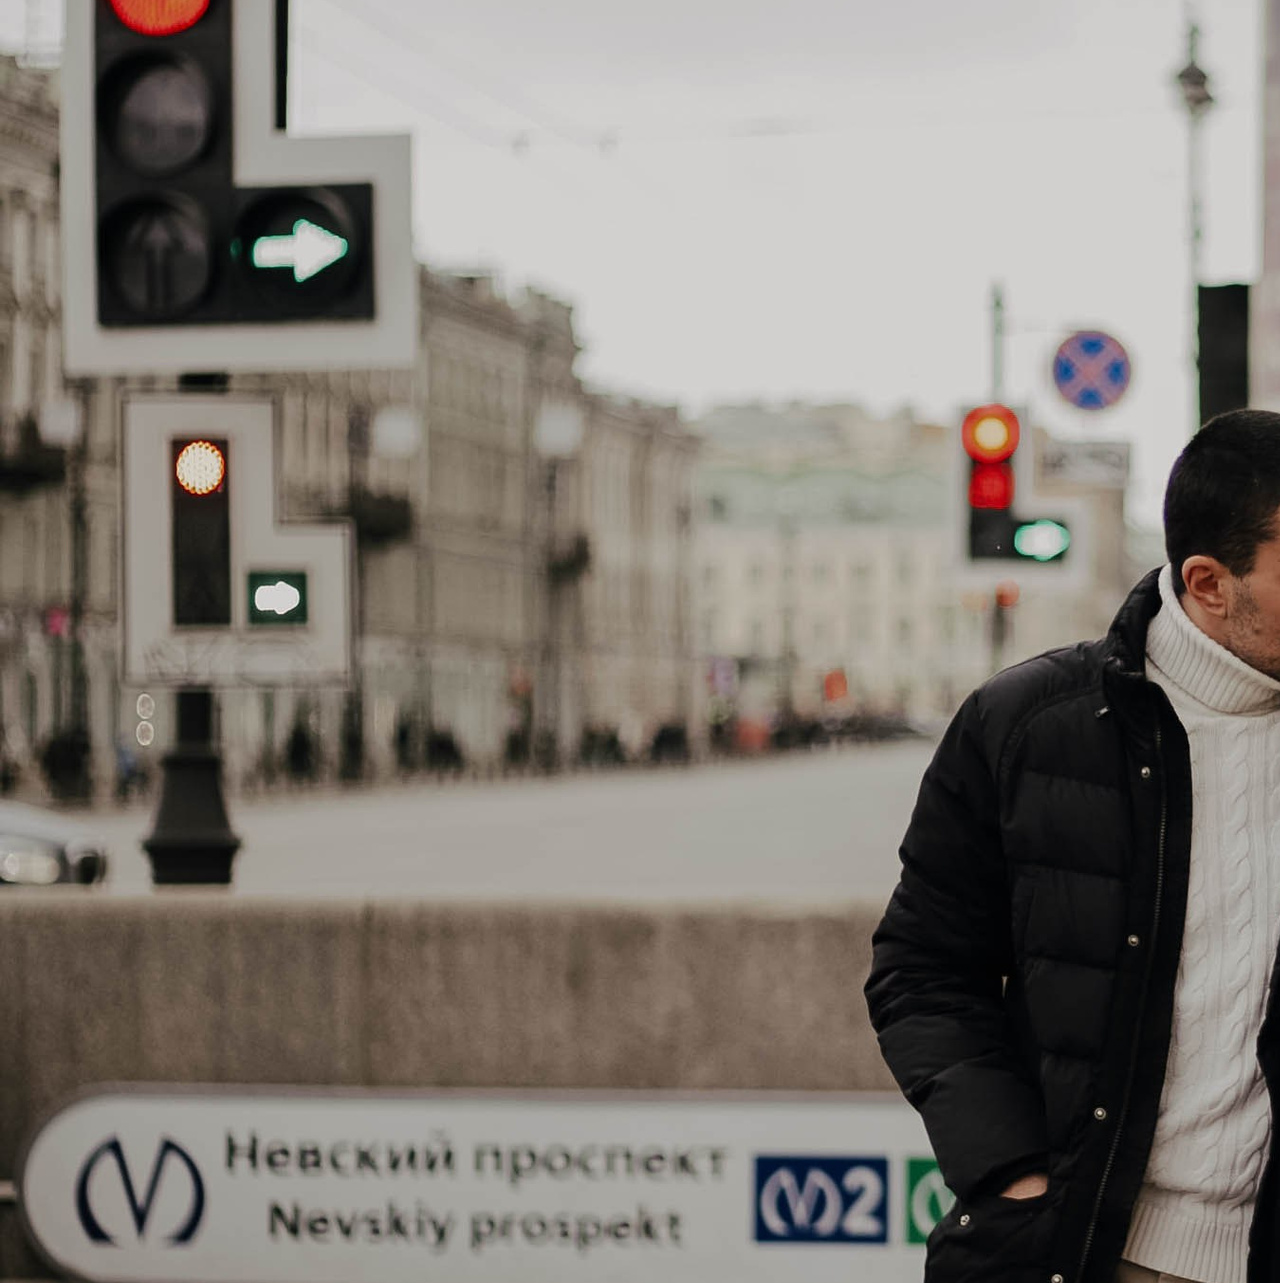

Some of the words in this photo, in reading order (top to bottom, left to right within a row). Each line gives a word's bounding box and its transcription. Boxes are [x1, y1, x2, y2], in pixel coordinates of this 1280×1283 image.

[225, 1127, 457, 1173] Невский
[473, 1141, 727, 1186] проспект
[268, 1201, 453, 1253] Nevskiy
[470, 1203, 682, 1255] prospekt
